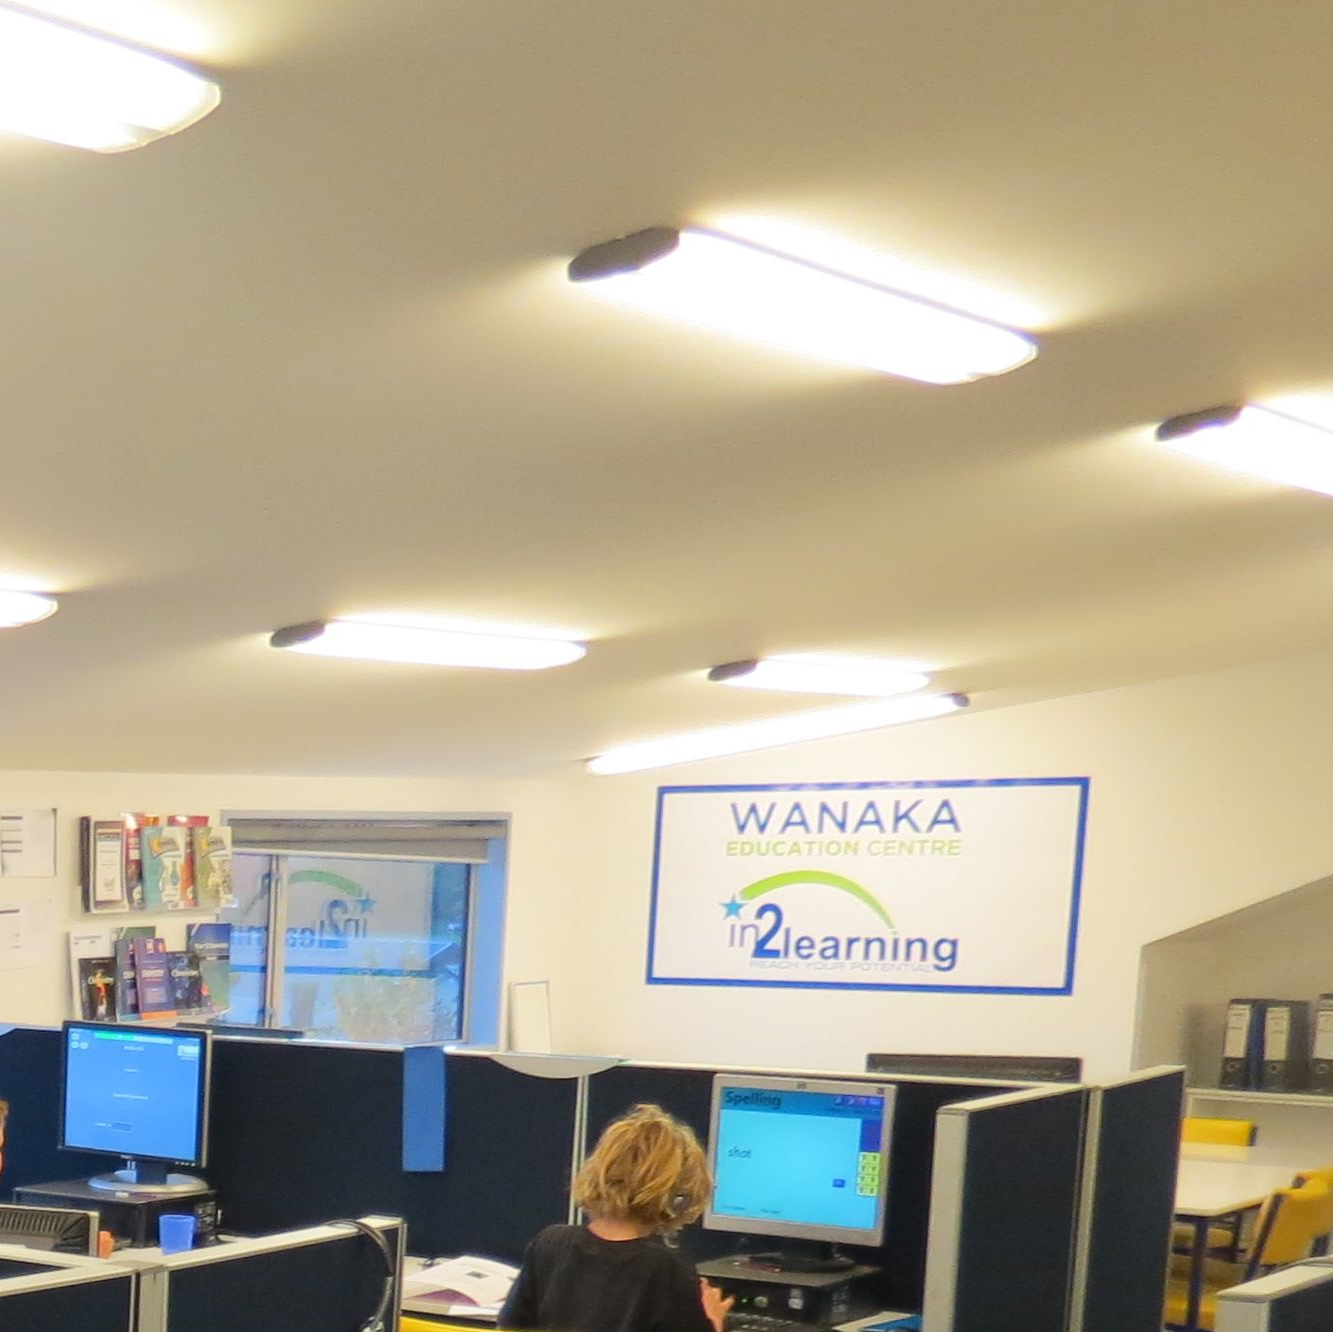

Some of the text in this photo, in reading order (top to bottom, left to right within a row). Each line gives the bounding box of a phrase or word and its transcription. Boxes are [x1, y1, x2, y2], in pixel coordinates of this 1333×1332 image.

[730, 798, 962, 836] WANAKA
[725, 839, 963, 857] EDUCATION CENTRE
[724, 1090, 782, 1111] Spelling
